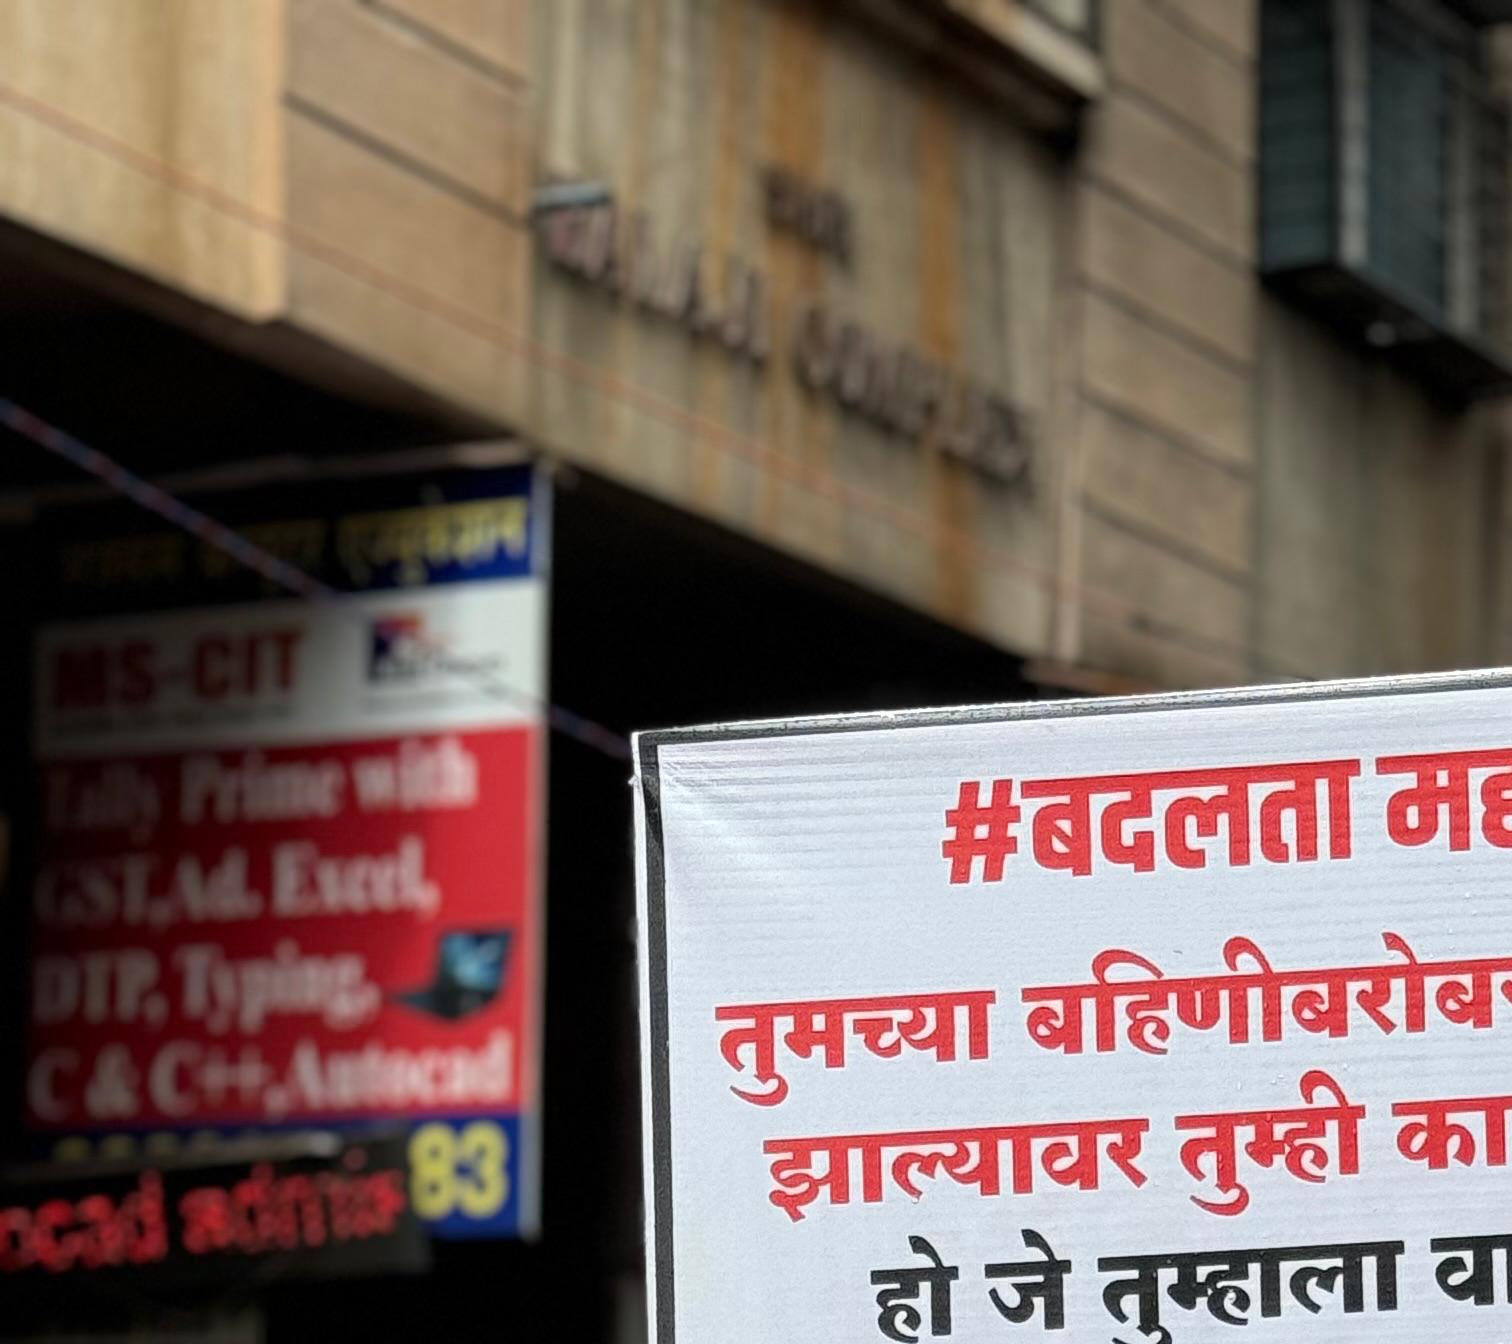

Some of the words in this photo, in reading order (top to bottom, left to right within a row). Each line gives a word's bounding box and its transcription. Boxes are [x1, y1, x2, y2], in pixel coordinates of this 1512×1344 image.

[53, 630, 306, 709] MS-CIT
[177, 750, 345, 828] Prime
[353, 735, 479, 813] with
[943, 758, 1361, 884] #बदलता
[715, 990, 996, 1106] तुमच्या
[764, 1118, 1149, 1221] झाल्यावर
[1175, 1069, 1367, 1217] तुम्ही
[870, 1235, 959, 1344] हो
[984, 1228, 1072, 1330] जे
